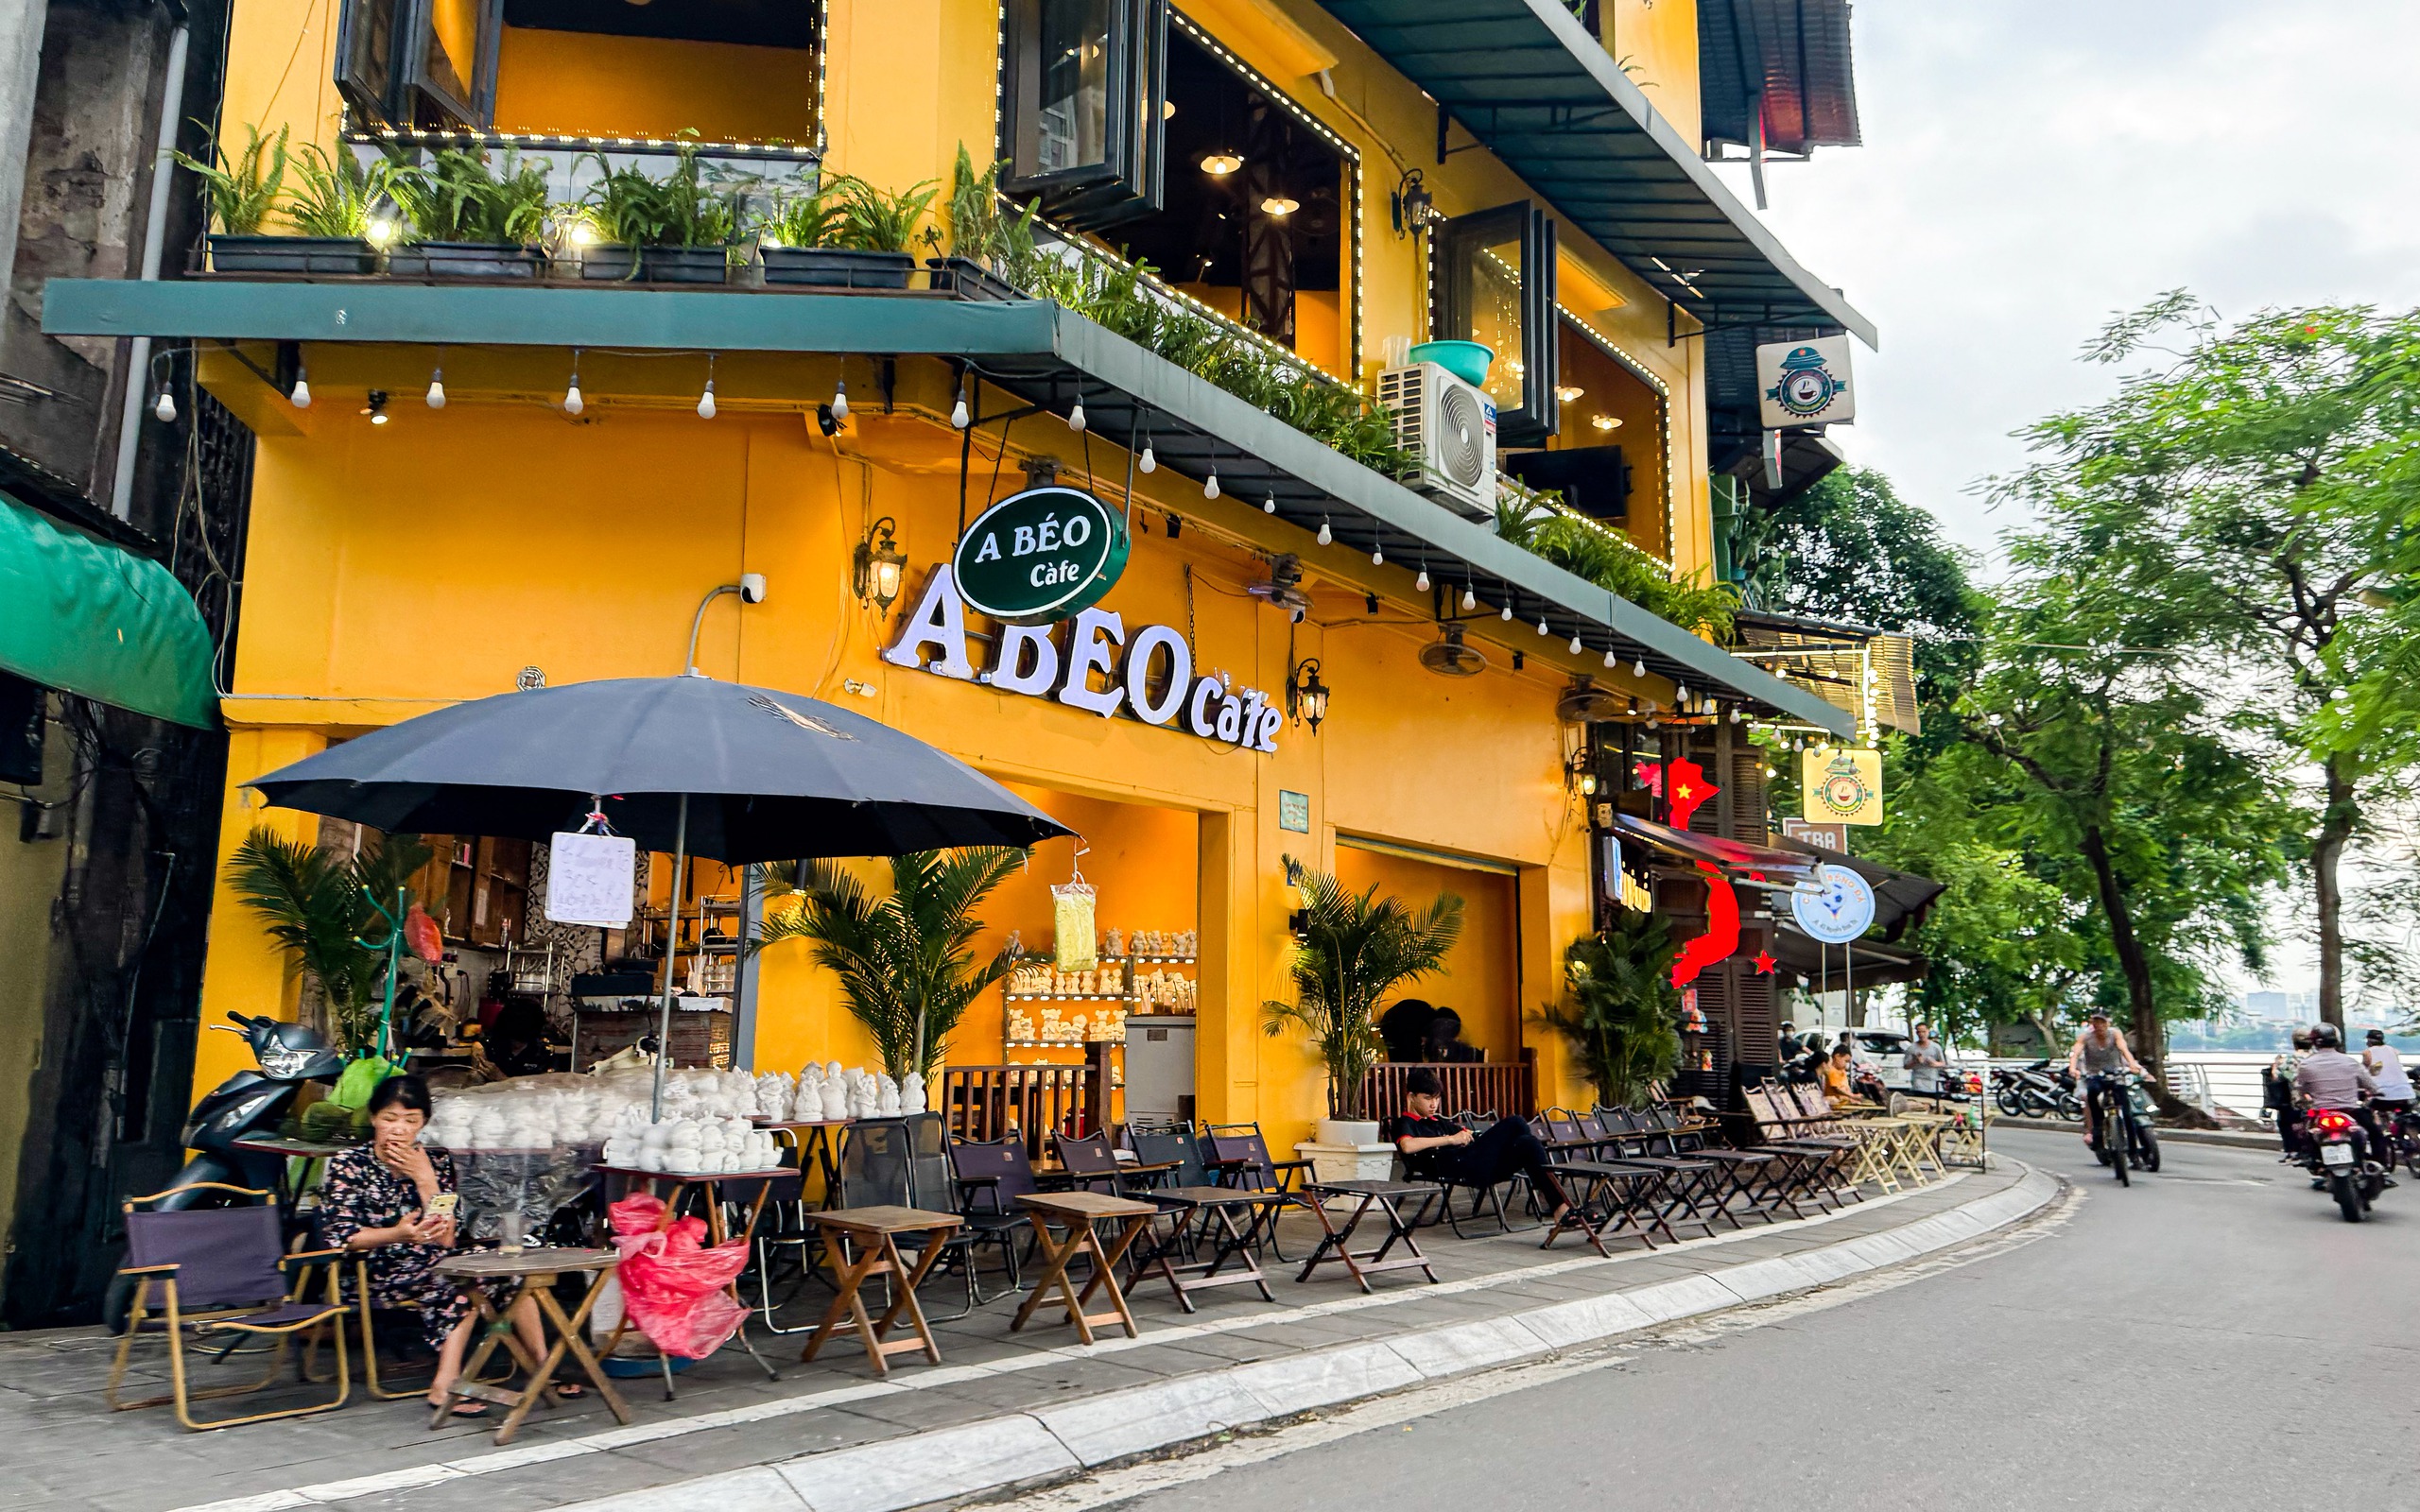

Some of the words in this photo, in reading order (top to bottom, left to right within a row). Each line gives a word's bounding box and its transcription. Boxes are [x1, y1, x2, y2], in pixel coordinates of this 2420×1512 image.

[975, 532, 1002, 563] A
[1011, 512, 1091, 557] BÉO
[1030, 559, 1080, 588] Càfe
[895, 563, 974, 679] A
